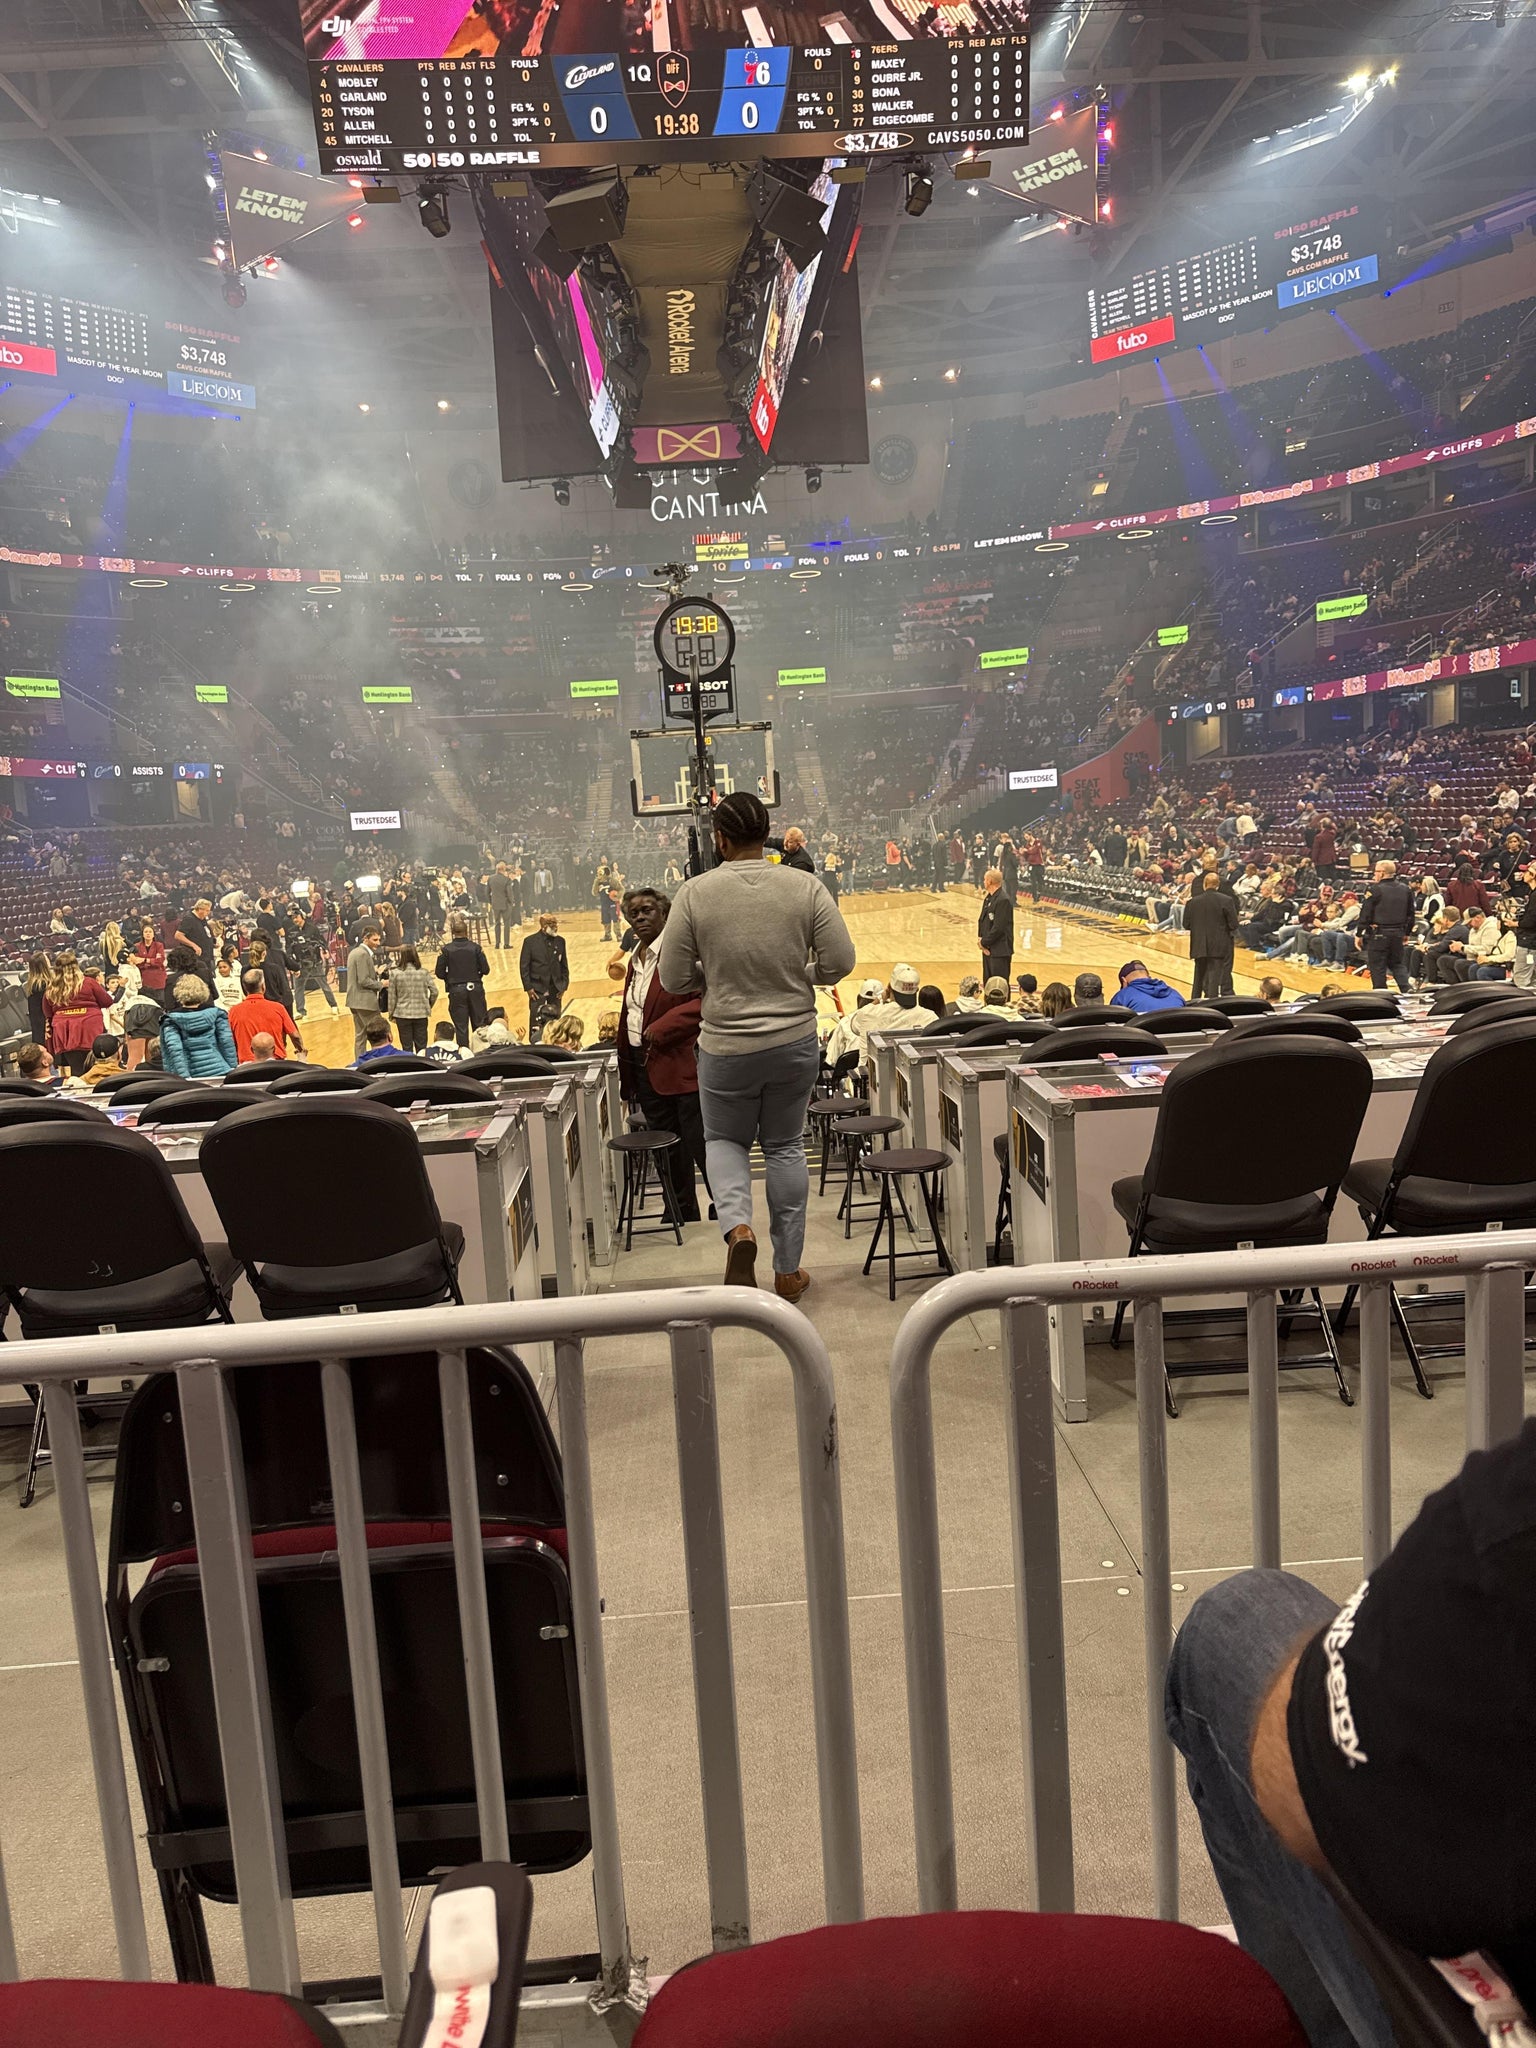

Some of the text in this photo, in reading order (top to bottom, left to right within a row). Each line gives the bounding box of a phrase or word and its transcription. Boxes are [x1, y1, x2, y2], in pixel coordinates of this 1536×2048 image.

[948, 35, 1027, 49] PTS REB AST FLS
[804, 48, 831, 57] FOULS
[871, 44, 898, 54] 76ERS
[511, 59, 539, 69] FOULS
[814, 58, 822, 70] 0
[853, 50, 1022, 71] 0 MAXEY 0 0 0 0
[336, 61, 496, 73] CAVALIERS PTS REB AST FLS
[628, 64, 651, 82] 1Q
[666, 62, 680, 74] DIFF
[744, 61, 771, 85] 76
[522, 70, 530, 81] 0
[854, 71, 923, 84] 9 OUBRE JR.
[320, 76, 492, 88] 4 MOBLEY 0 0 0 0
[320, 92, 387, 103] 10 GARLAND
[797, 92, 833, 102] FG % 0
[852, 87, 900, 99] 30 BONA
[321, 107, 374, 117] 20 TYSON
[511, 102, 549, 112] FG % 0
[797, 106, 834, 116] 3PT % 0
[852, 100, 913, 113] 33 WALKER
[590, 106, 608, 134] 0
[741, 101, 759, 129] 0
[853, 112, 934, 127] 77 EDGECOMBE
[323, 121, 375, 131] 31 ALLEN
[512, 117, 551, 127] 3PT % 0
[654, 113, 699, 136] 19:38
[798, 119, 840, 130] TOL 7
[325, 132, 498, 146] 45 MITCHELL 0 0 0 0
[513, 132, 556, 142] TOL 7
[928, 126, 1024, 145] CAVS5050.COM
[844, 132, 899, 152] $3,748
[336, 150, 382, 165] oswald
[470, 151, 540, 166] RAFFLE
[1012, 147, 1078, 180] LET EM
[1018, 159, 1088, 193] KNOW.
[240, 187, 308, 211] LET EM
[235, 199, 304, 224] KNOW.
[1309, 205, 1359, 228] RAFFLE
[1290, 234, 1342, 263] $3,748
[1182, 308, 1208, 321] MASCOT
[1209, 306, 1219, 314] OF
[1219, 302, 1232, 311] THE
[1252, 289, 1273, 301] MOON
[1088, 289, 1098, 338] CAVALIERS
[667, 303, 695, 374] Rocket Arena
[1117, 333, 1147, 351] fubo
[181, 344, 226, 366] $3,748
[67, 356, 95, 367] MASCOT
[97, 361, 107, 369] OF
[109, 363, 121, 372] THE
[142, 369, 163, 379] MOON
[1442, 438, 1483, 456] CLIFFS
[651, 491, 768, 522] CANTINA
[1109, 515, 1146, 528] CLIFFS
[949, 543, 960, 551] PM
[974, 538, 993, 548] LET
[994, 537, 1010, 545] EM
[705, 545, 739, 559] Sprite
[844, 551, 882, 563] FOULS 0
[894, 547, 921, 557] TOL 7
[823, 556, 829, 565] 0
[196, 567, 234, 577] CLIFFS
[712, 563, 727, 572] 1Q
[455, 574, 484, 582] TOL 7
[526, 573, 533, 582] 0
[569, 571, 575, 580] 0
[676, 615, 718, 635] 19:38
[684, 680, 729, 692] TSSOT
[1216, 697, 1255, 711] 1Q 19:38
[132, 765, 186, 776] ASSISTS 0
[1013, 774, 1054, 784] TRUSTEDSEC
[1074, 778, 1100, 789] SEAT
[1073, 789, 1101, 799] GEK
[354, 816, 397, 825] TRUSTEDSEC
[1360, 1259, 1397, 1271] Rocket
[1423, 1254, 1459, 1265] Rocket
[1082, 1280, 1119, 1289] Rocket
